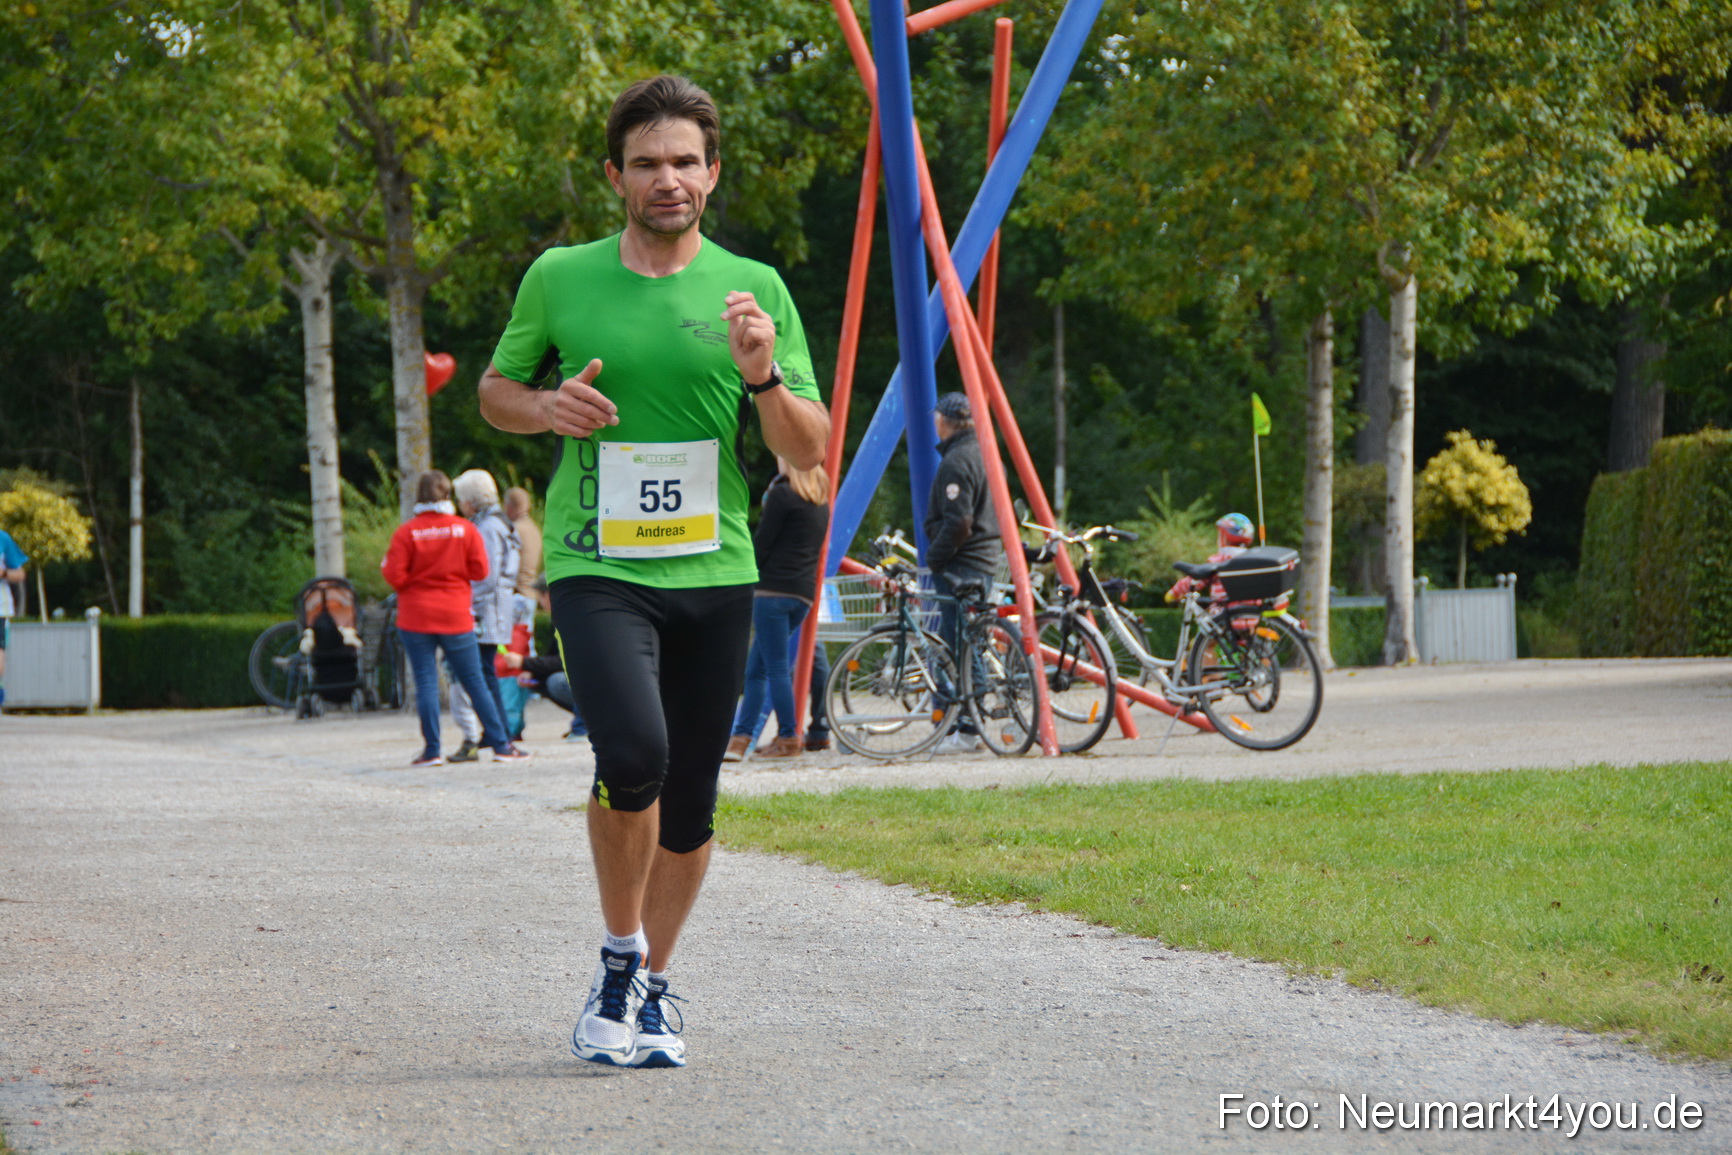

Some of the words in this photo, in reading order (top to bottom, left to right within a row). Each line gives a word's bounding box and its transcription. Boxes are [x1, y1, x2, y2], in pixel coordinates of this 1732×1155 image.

[645, 453, 687, 464] BOCK
[639, 479, 682, 513] 55
[635, 525, 686, 538] Andreas
